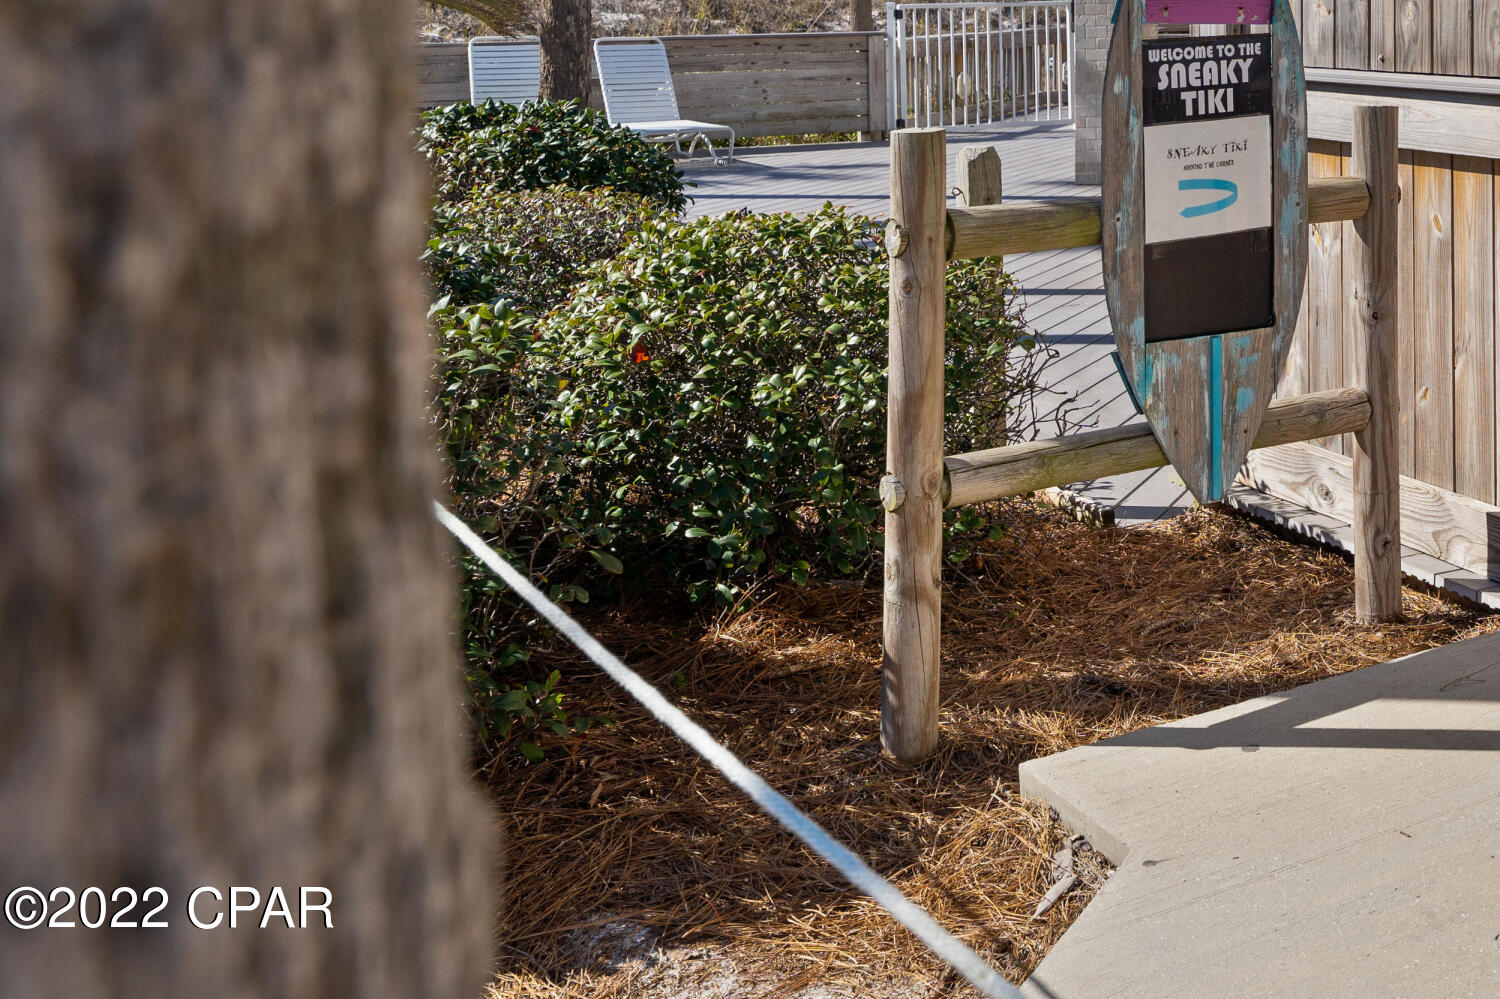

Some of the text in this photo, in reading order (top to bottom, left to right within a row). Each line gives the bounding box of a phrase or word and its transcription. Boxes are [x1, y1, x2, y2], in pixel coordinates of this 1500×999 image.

[1148, 42, 1262, 63] WELCOME TO THE
[1157, 57, 1254, 91] SNEAKY
[1180, 87, 1234, 117] TIKI
[1166, 143, 1217, 160] SNEAKY
[1183, 159, 1235, 171] AROUND THE CORNER
